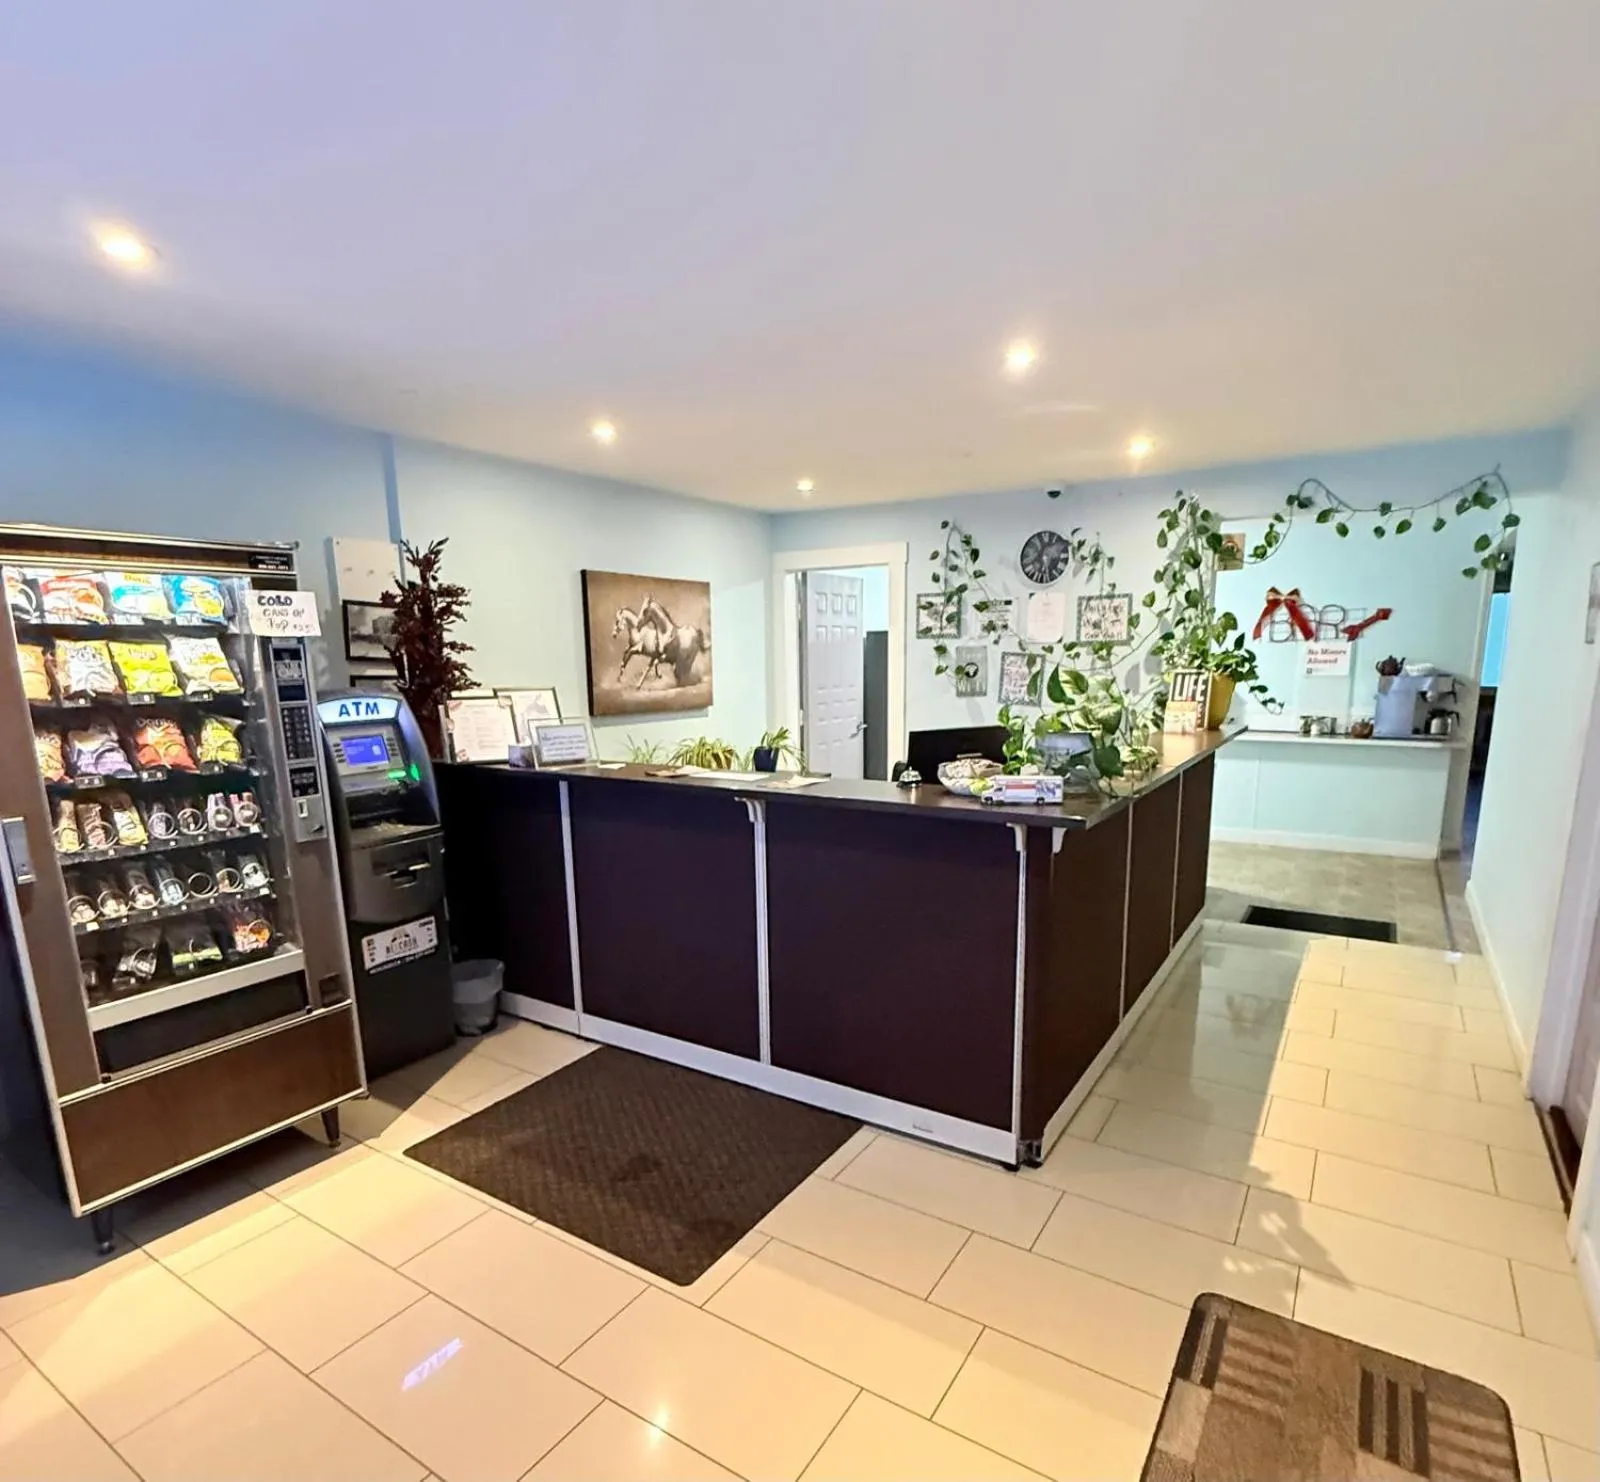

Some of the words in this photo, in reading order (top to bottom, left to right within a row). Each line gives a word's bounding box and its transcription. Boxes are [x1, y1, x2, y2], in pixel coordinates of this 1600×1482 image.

[257, 595, 293, 607] COLD
[1172, 673, 1207, 702] LIFE
[338, 701, 381, 717] ATM
